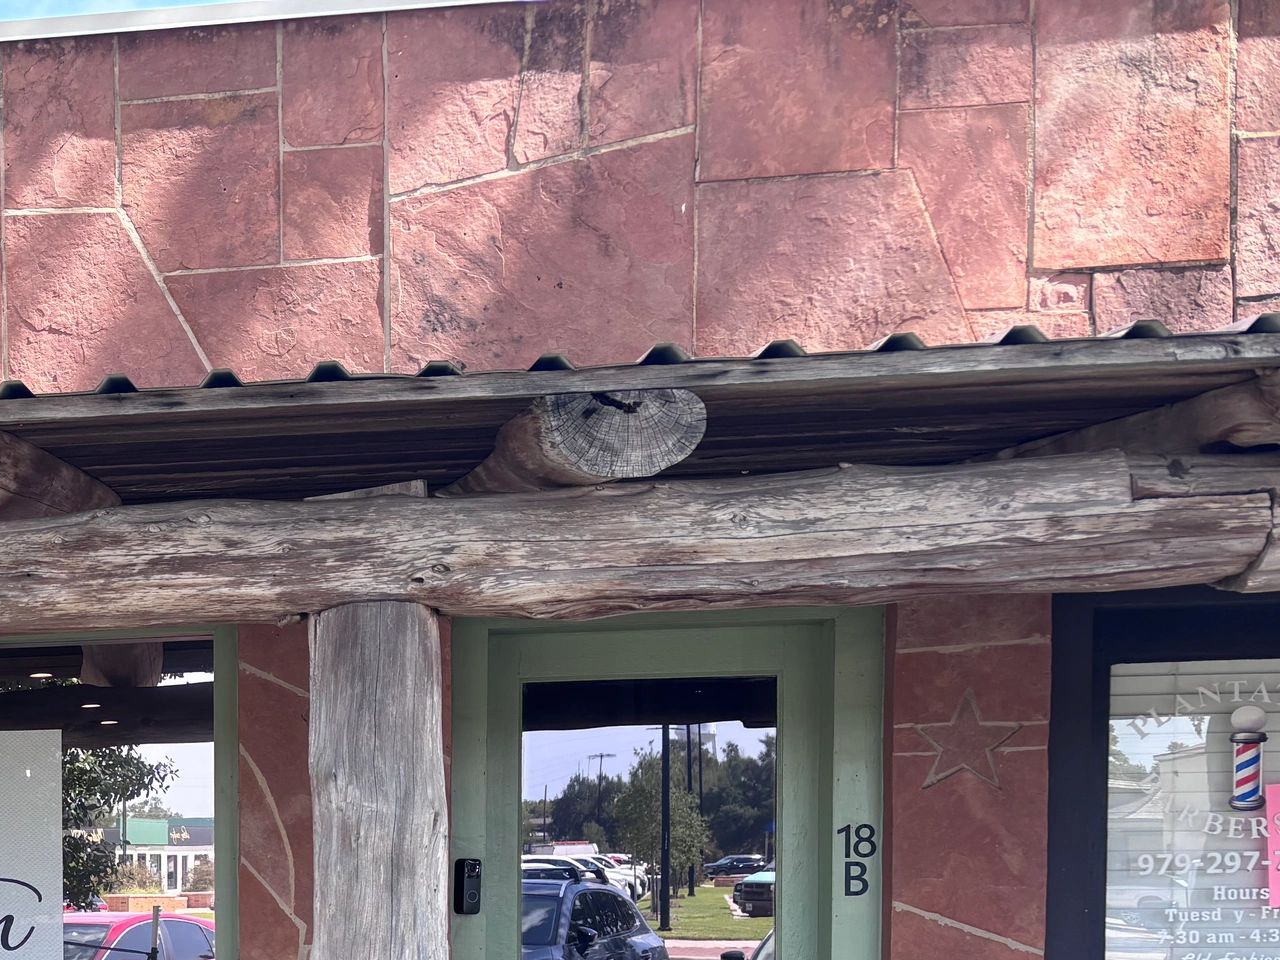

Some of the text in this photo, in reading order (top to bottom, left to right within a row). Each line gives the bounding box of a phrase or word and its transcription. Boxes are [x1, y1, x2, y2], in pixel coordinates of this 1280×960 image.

[1127, 680, 1280, 740] PLANTA
[837, 824, 877, 858] 18
[845, 861, 869, 896] B
[1213, 885, 1270, 900] Hours
[1206, 932, 1235, 943] am
